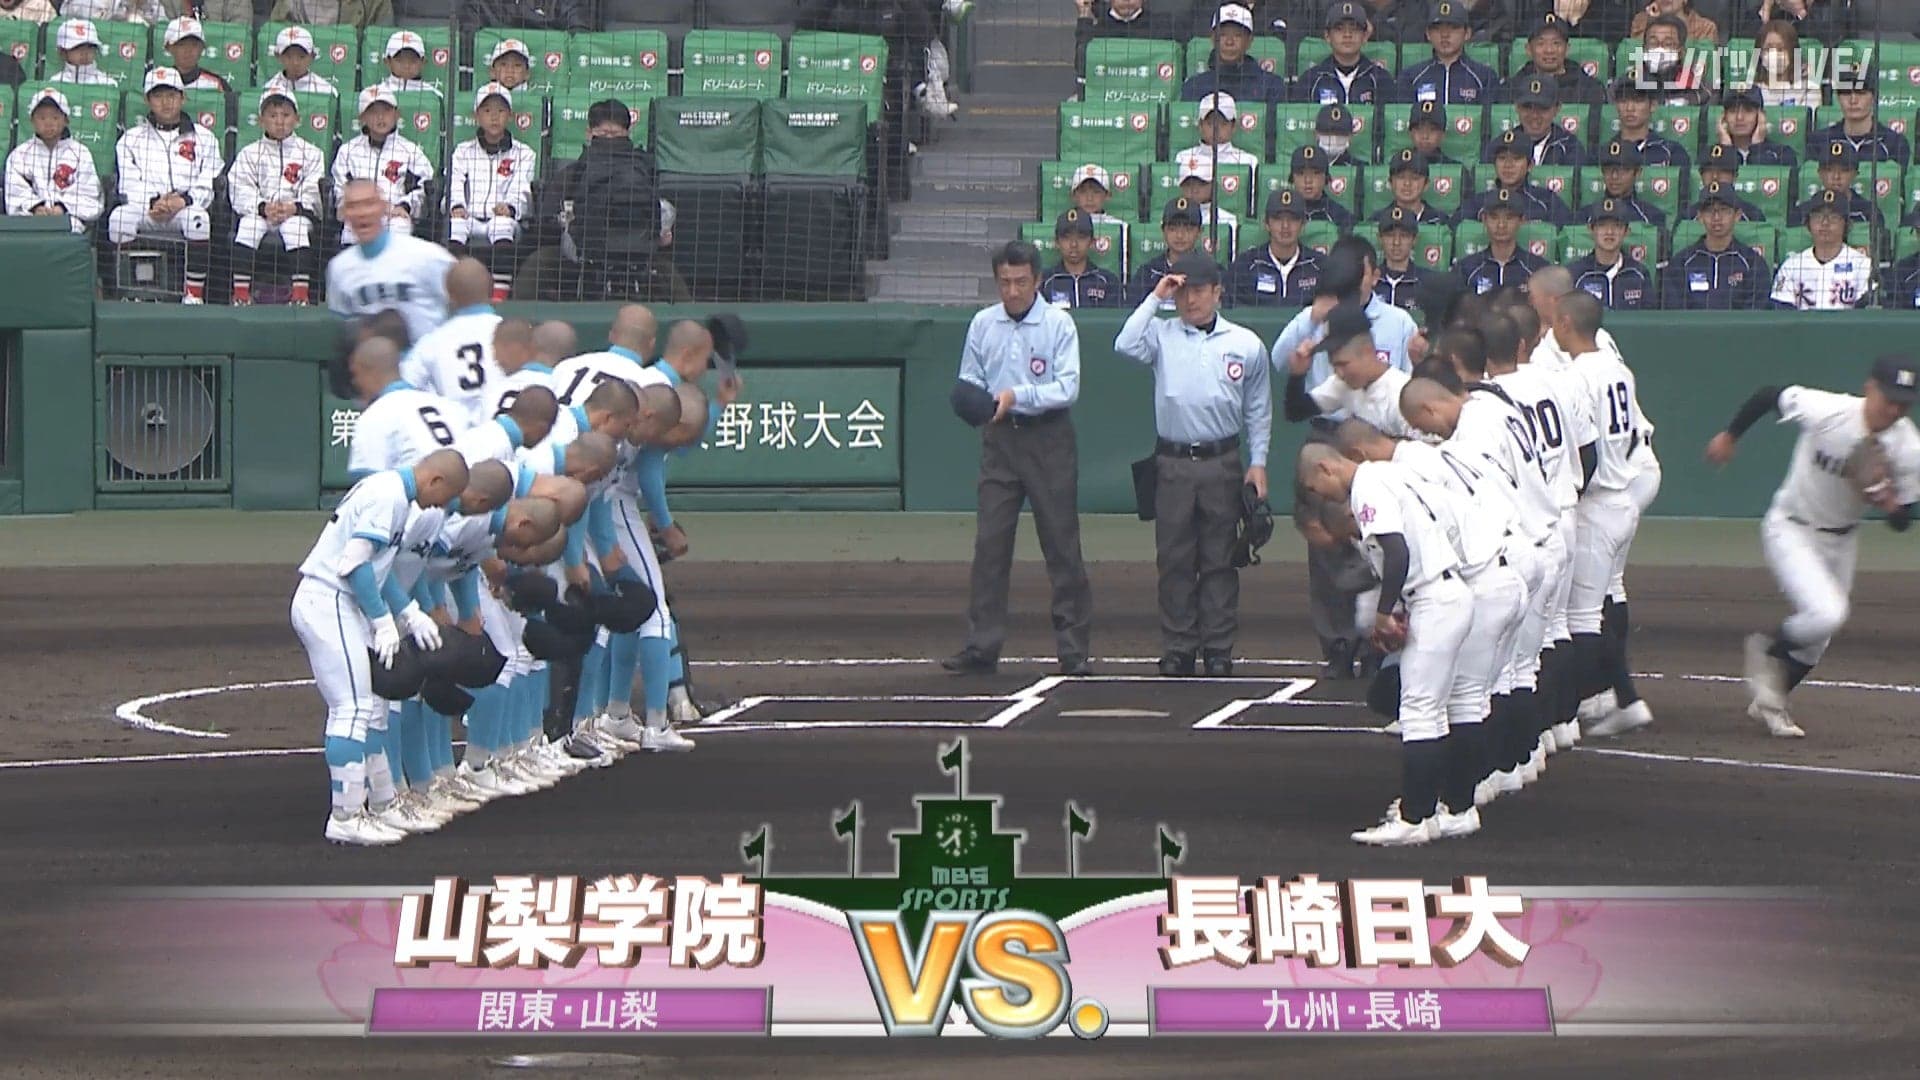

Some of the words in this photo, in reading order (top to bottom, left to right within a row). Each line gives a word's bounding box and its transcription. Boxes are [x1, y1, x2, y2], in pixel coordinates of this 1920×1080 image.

[457, 342, 485, 391] 3
[418, 405, 455, 447] 6
[701, 400, 884, 450] 野球大会
[1606, 381, 1630, 434] 19
